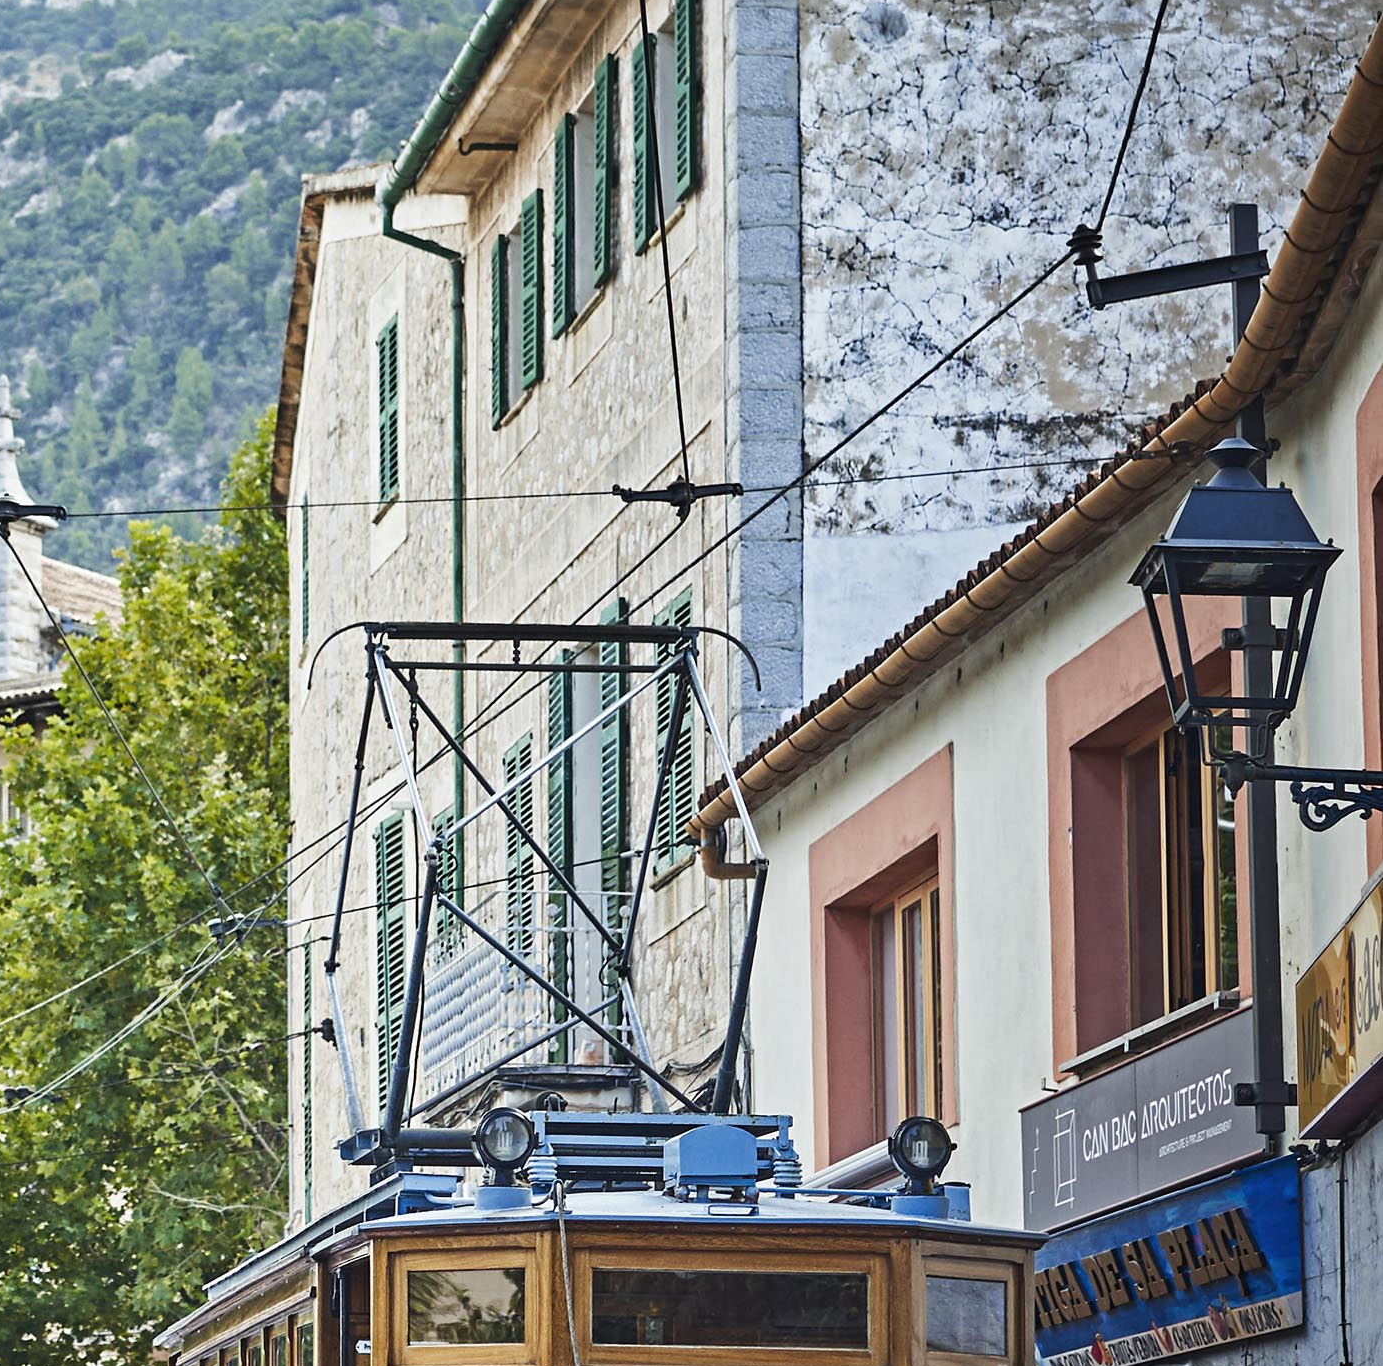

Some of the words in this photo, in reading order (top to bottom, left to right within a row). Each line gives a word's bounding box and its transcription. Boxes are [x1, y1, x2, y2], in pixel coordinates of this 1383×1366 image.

[1083, 1121, 1108, 1161] CAN
[1111, 1110, 1136, 1151] BAC
[1140, 1068, 1232, 1139] ARQUITECTOS
[1081, 1248, 1130, 1313] DE
[1121, 1237, 1168, 1301] SA
[1157, 1207, 1265, 1297] PLAÇA
